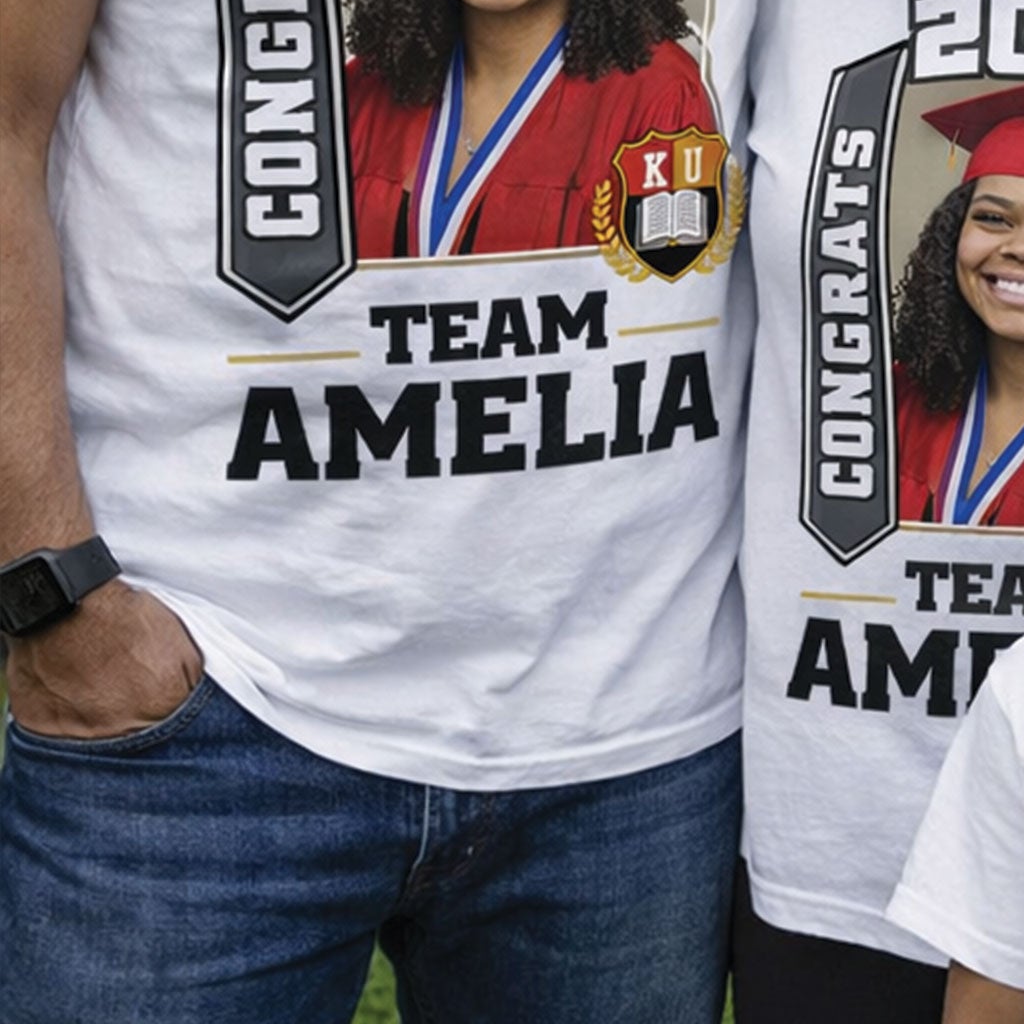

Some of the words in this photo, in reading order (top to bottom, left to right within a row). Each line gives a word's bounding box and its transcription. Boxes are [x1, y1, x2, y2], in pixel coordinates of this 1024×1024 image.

[369, 290, 608, 365] TEAM
[818, 126, 877, 500] CONGRATS
[226, 350, 720, 481] AMELIA
